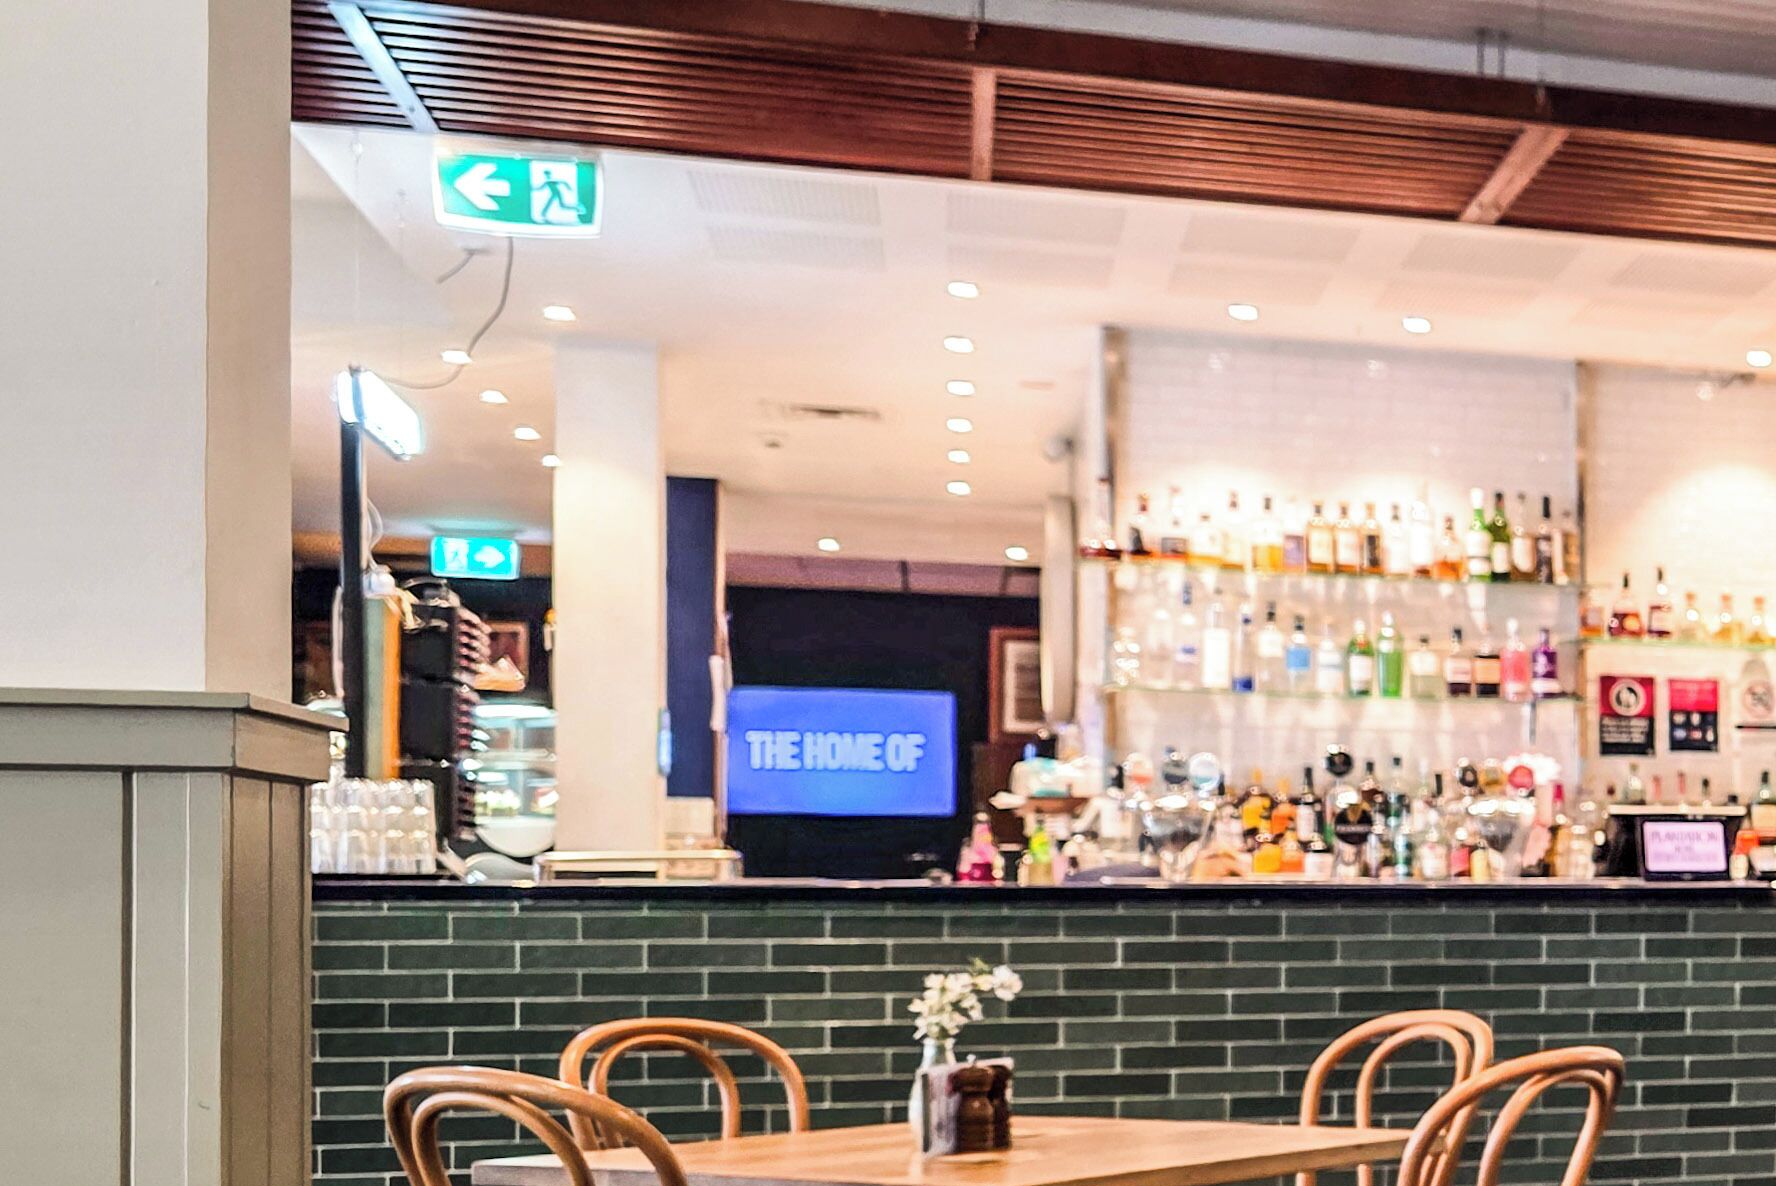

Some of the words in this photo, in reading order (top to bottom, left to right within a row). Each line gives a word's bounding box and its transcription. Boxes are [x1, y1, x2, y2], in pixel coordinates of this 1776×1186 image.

[745, 730, 802, 771] THE
[803, 731, 886, 772] HOME
[886, 732, 927, 773] OF
